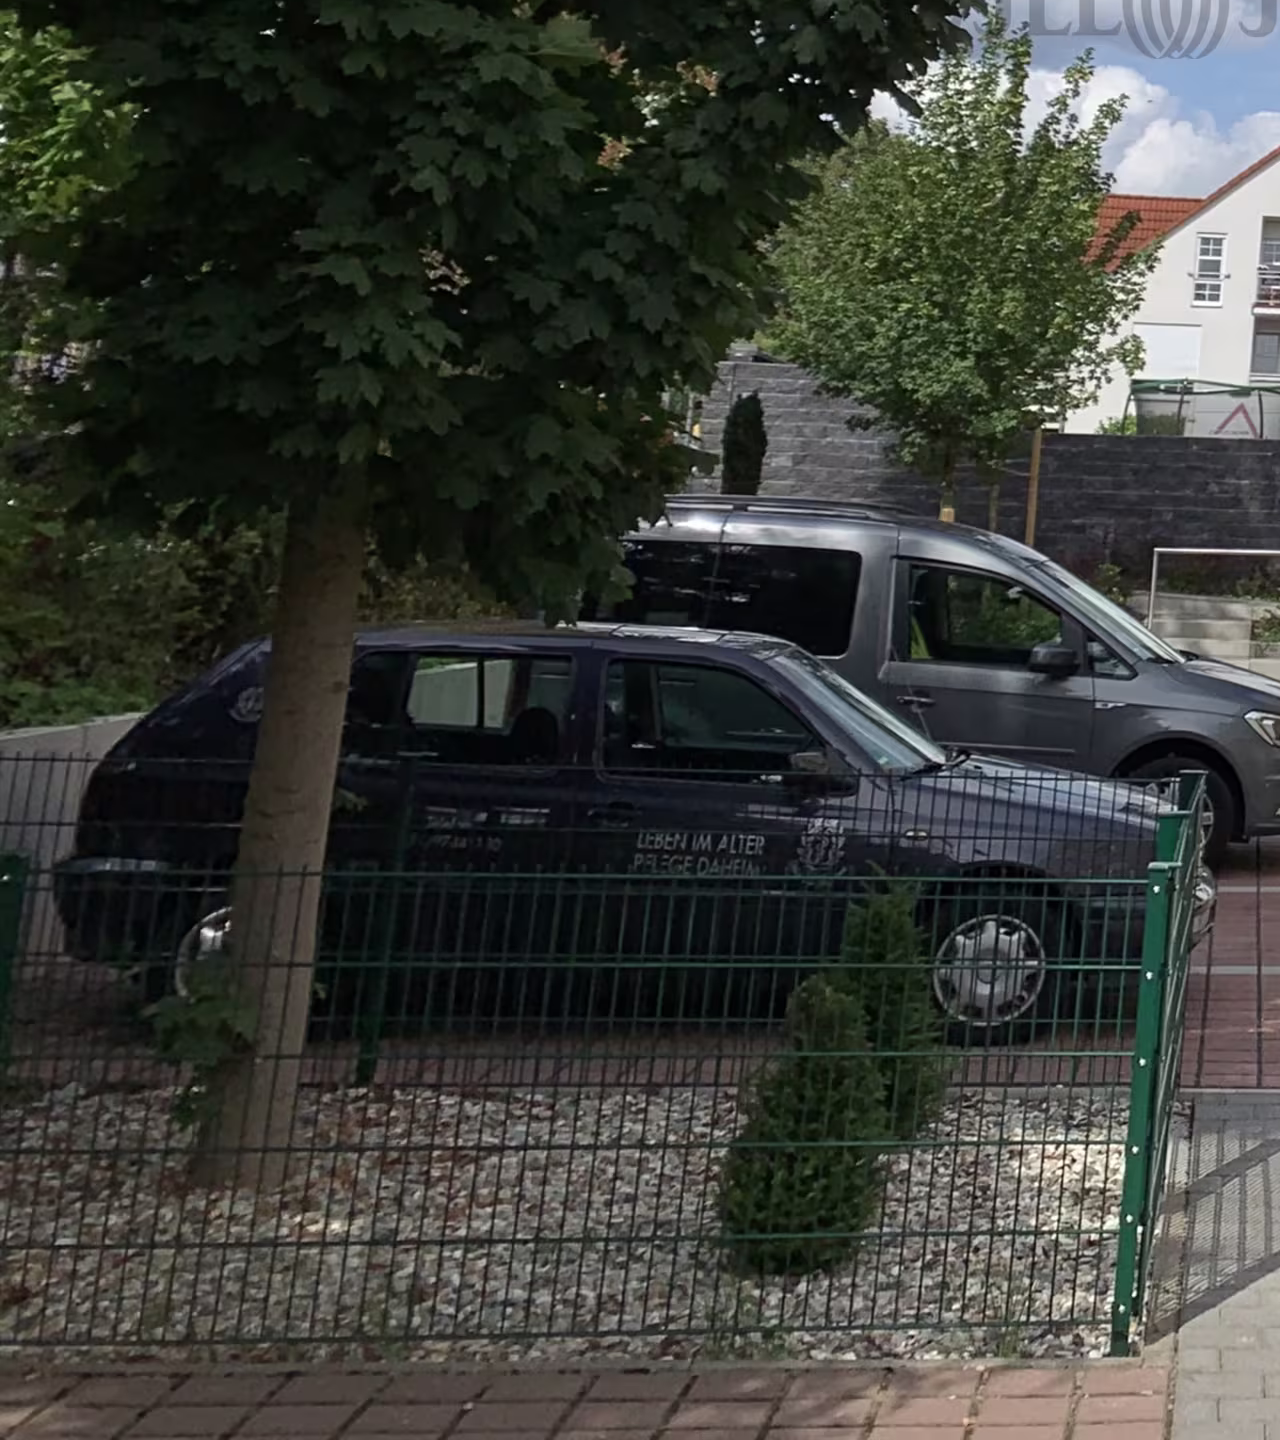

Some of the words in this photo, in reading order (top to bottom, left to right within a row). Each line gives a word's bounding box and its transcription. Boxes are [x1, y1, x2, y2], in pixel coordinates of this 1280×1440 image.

[636, 831, 687, 851] LEBEN
[691, 833, 712, 852] IM
[716, 834, 766, 855] ALTER
